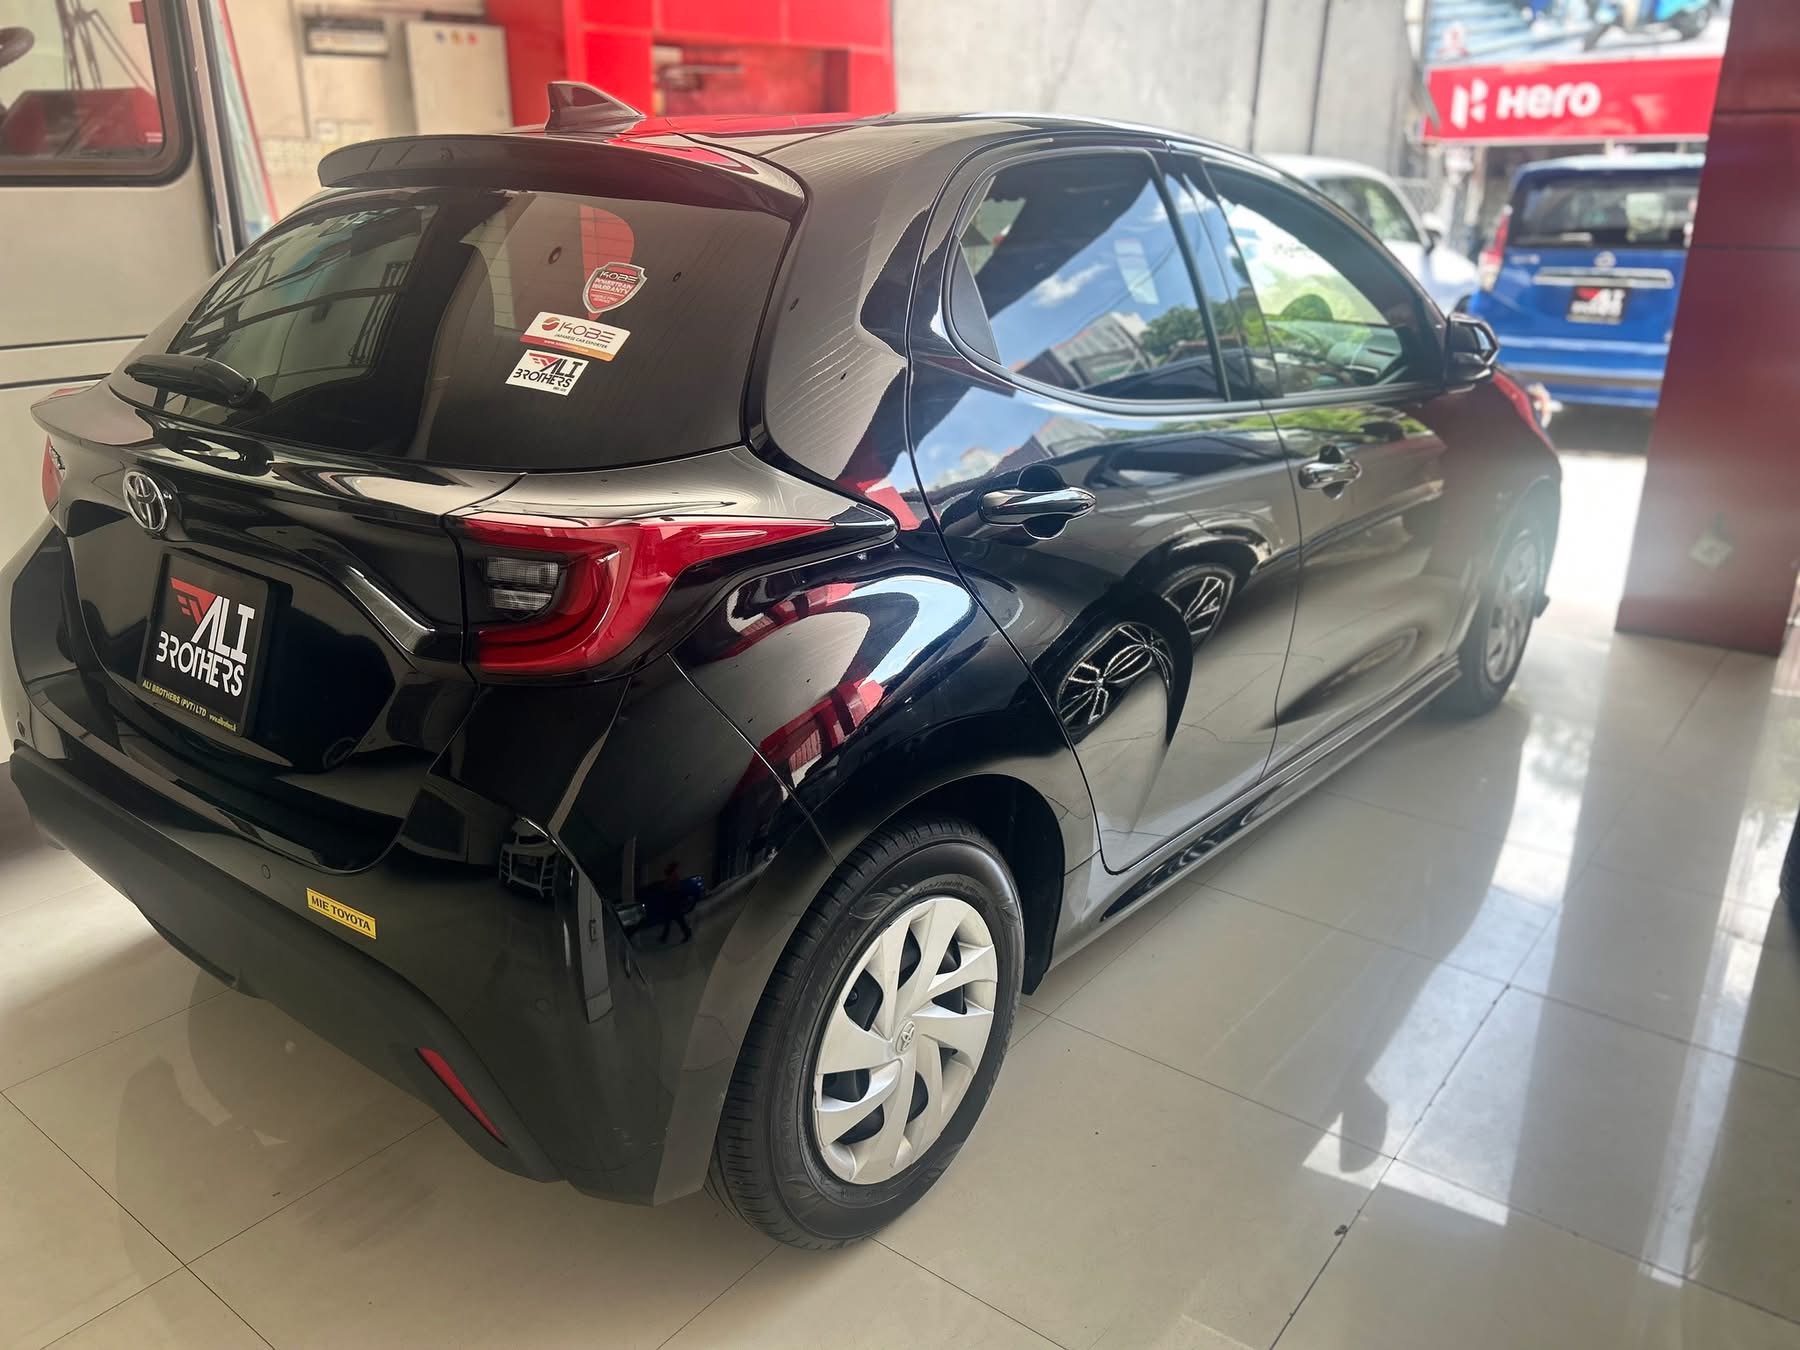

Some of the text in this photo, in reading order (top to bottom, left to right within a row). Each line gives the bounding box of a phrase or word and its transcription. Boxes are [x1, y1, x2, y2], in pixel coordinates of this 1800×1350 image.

[1496, 81, 1601, 119] Hero
[600, 271, 638, 284] KOBE
[554, 333, 576, 342] JAPANESE
[585, 340, 608, 349] EXPORTER
[558, 322, 616, 343] KOBE
[513, 368, 572, 388] BROTHERS
[540, 358, 583, 378] ALI
[190, 595, 255, 664] ALI
[156, 630, 245, 697] BROTHERS
[142, 679, 152, 690] ALI
[152, 684, 180, 705] BROTHERS
[311, 896, 371, 931] MIE TOYOTA
